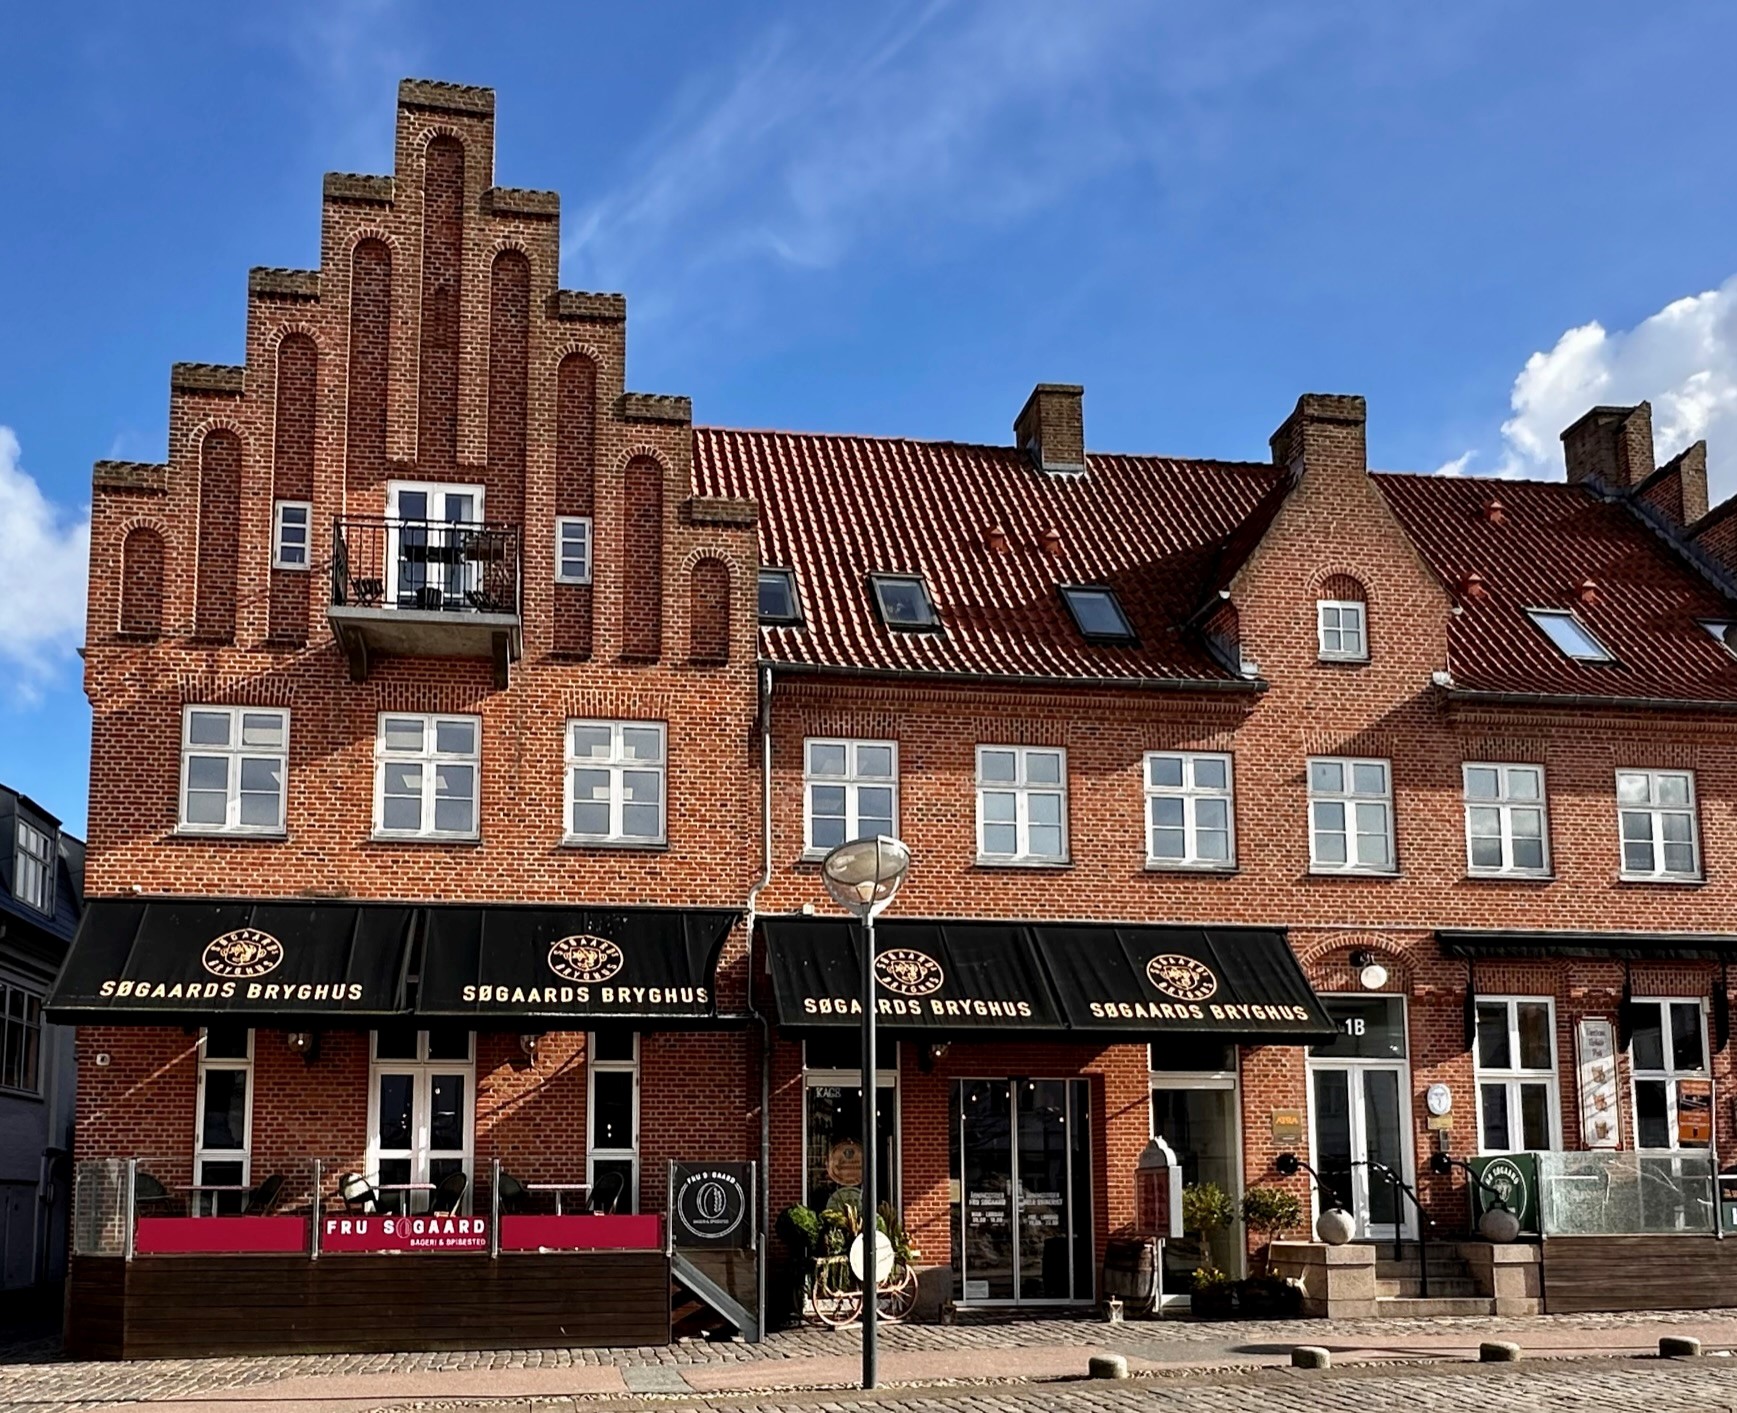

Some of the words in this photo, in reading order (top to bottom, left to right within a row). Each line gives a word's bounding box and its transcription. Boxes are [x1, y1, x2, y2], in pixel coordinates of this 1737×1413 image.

[99, 980, 237, 998] SØGAARDS
[246, 982, 364, 1000] BRYGHUS
[462, 984, 590, 1003] SØGAARDS
[601, 987, 708, 1003] BRYGHUS
[804, 998, 922, 1015] SØGARDS
[931, 999, 1032, 1017] BRYGHUS
[1090, 1002, 1204, 1019] SØGAARDS
[1209, 1004, 1308, 1021] BRYGHUS
[1345, 1018, 1365, 1036] 1B
[327, 1219, 368, 1235] FRU
[410, 1238, 437, 1246] BAGERI
[438, 1238, 445, 1246] &
